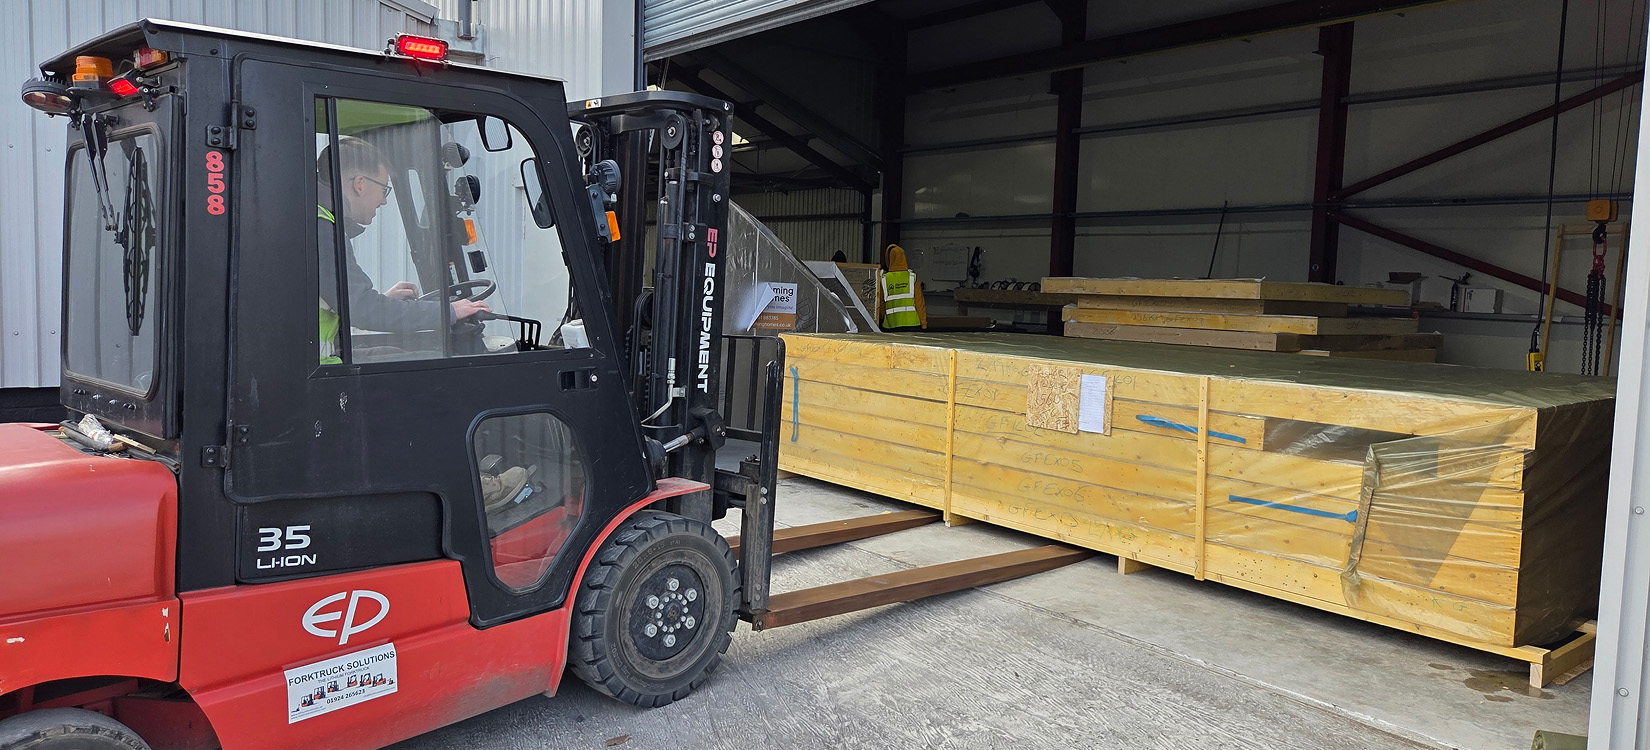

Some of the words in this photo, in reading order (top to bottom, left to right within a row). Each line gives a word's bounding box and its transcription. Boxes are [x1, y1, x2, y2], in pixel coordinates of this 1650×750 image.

[206, 151, 225, 215] 858
[707, 228, 718, 258] EP
[697, 262, 716, 393] EQUIPMENT
[258, 525, 311, 552] 35
[302, 590, 390, 645] EP
[289, 664, 345, 686] FORKTRUCK
[346, 650, 395, 670] SOLUTIONS
[326, 694, 344, 704] 01924
